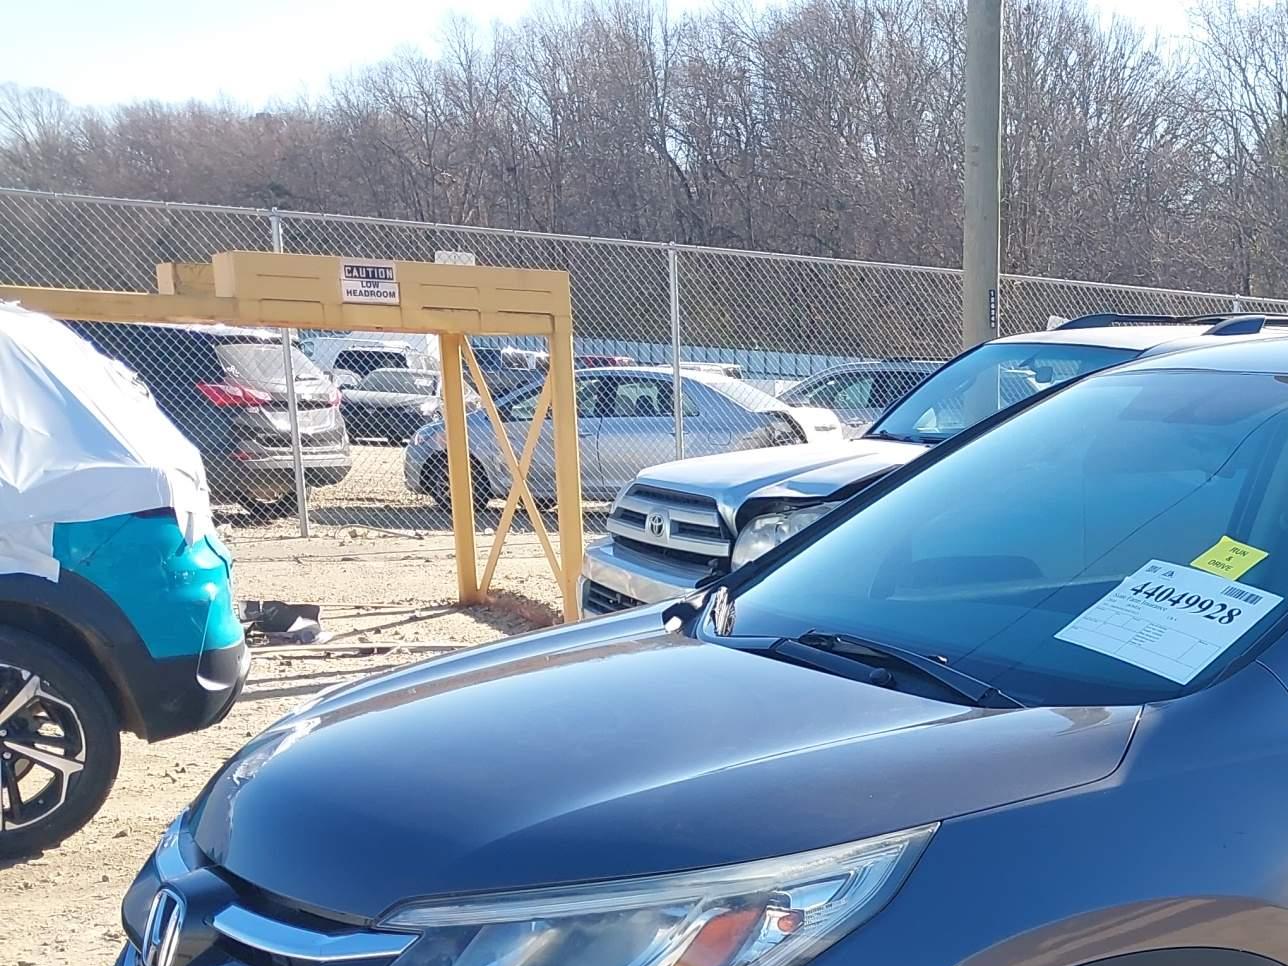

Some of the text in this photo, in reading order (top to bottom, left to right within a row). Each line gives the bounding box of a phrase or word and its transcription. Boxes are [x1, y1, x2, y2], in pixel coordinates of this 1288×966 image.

[344, 266, 393, 279] CAUTION
[360, 281, 380, 289] LOW
[346, 289, 396, 299] HEADROOM
[1229, 546, 1249, 557] RUN
[1208, 559, 1234, 571] DRIVE
[1129, 581, 1242, 625] 44049928
